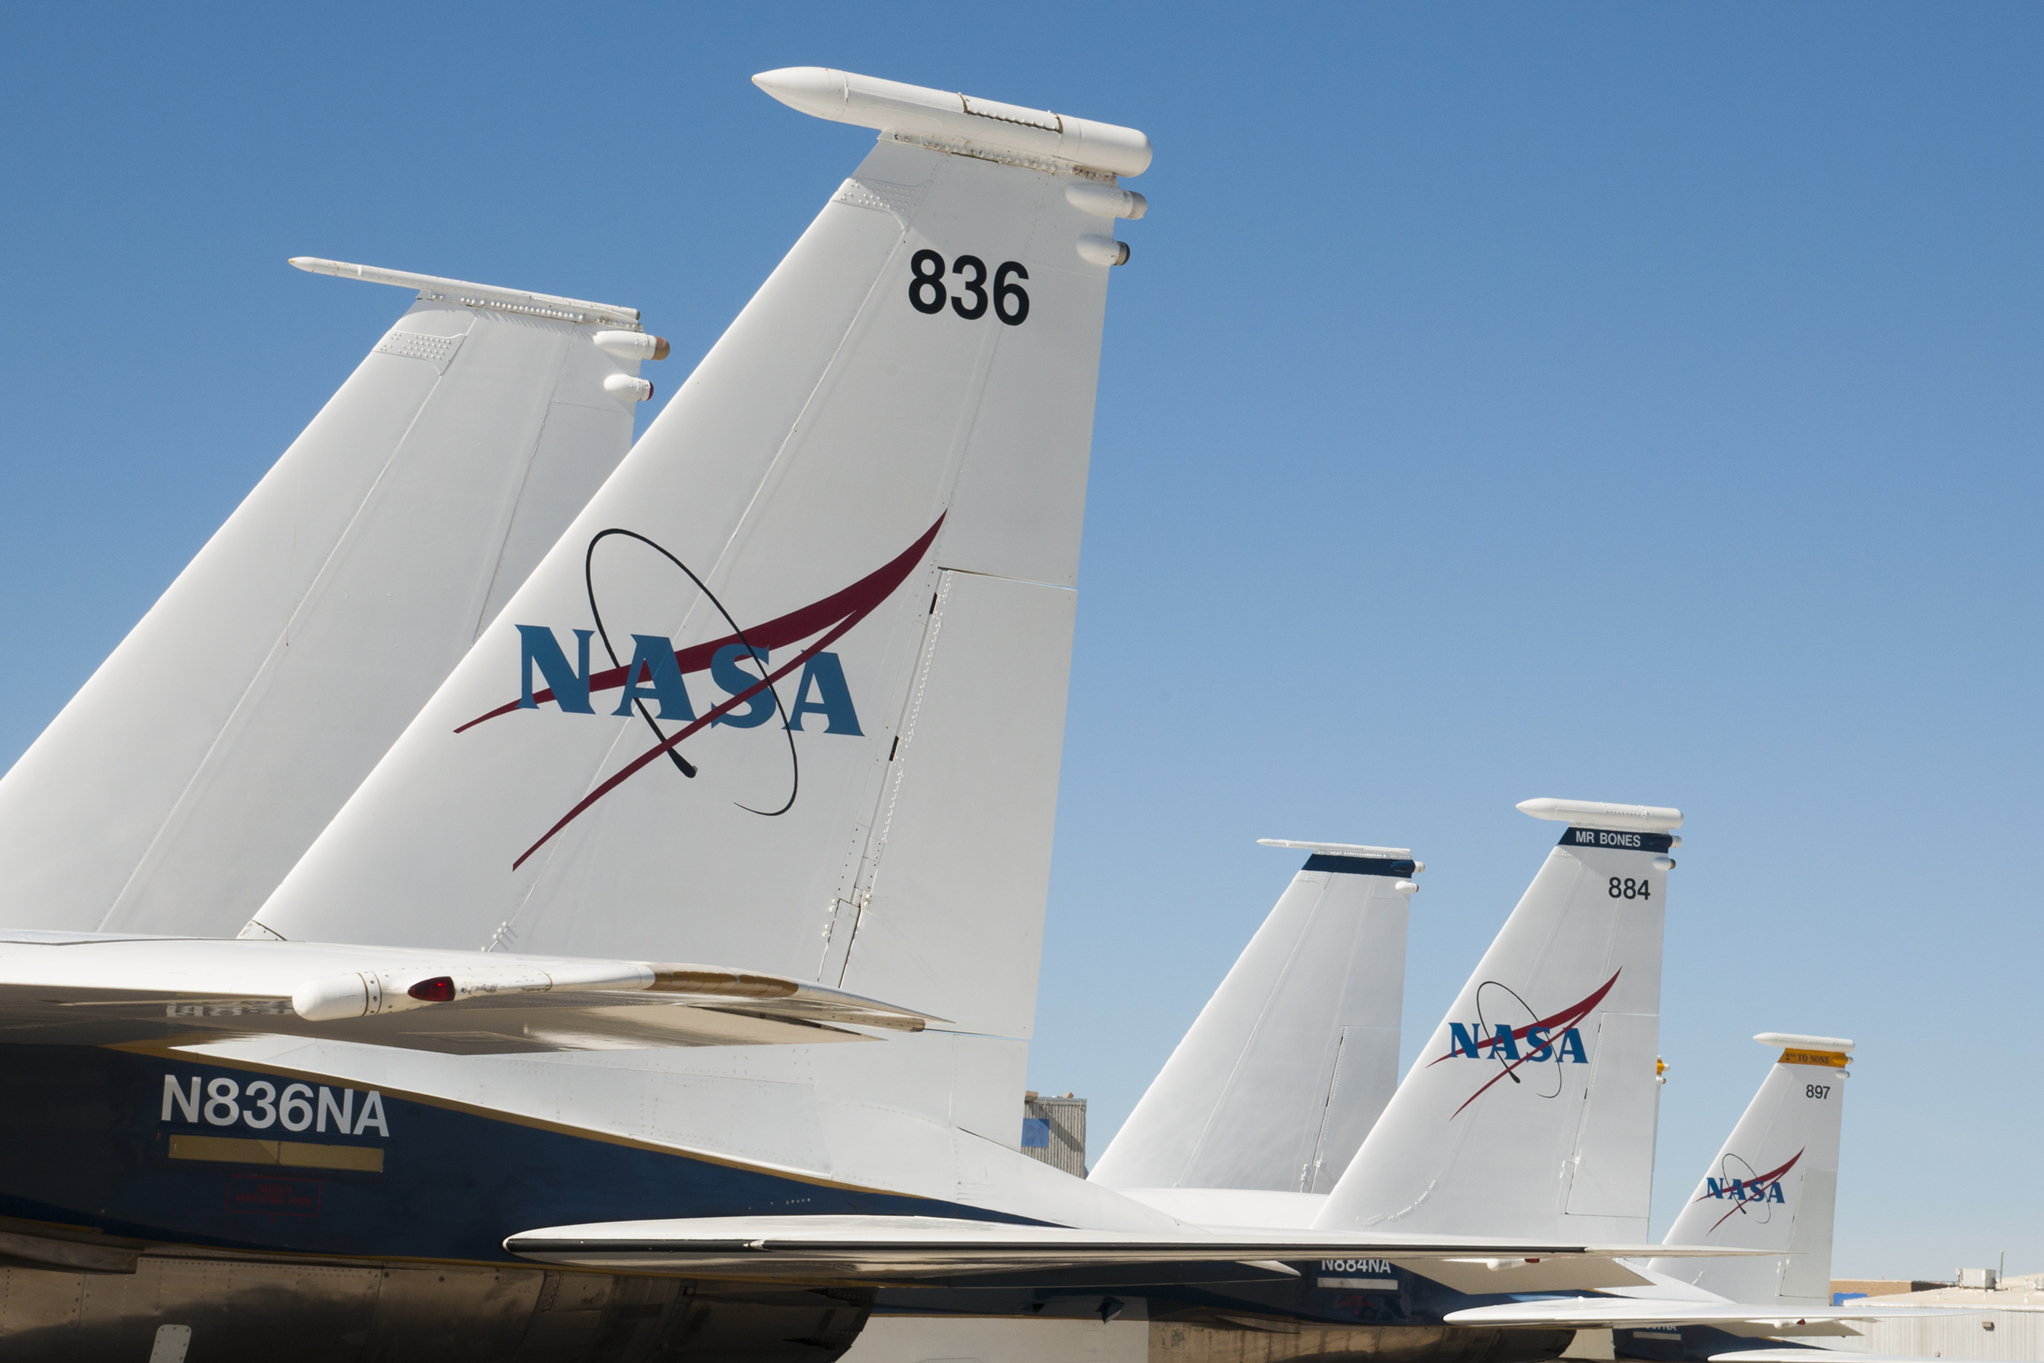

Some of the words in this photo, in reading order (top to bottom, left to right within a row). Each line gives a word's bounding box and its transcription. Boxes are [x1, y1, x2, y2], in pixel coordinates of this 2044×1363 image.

[909, 249, 1030, 326] 836
[514, 623, 866, 738] NASA
[1575, 831, 1595, 844] MR
[1599, 832, 1641, 847] BONES
[1608, 877, 1651, 901] 884
[1449, 1022, 1589, 1064] NASA
[1798, 1054, 1808, 1062] TO
[1810, 1055, 1830, 1064] NONE
[1805, 1084, 1830, 1099] 897
[161, 1073, 390, 1138] N836NA
[1706, 1177, 1786, 1204] NASA
[1321, 1259, 1391, 1273] N884NA
